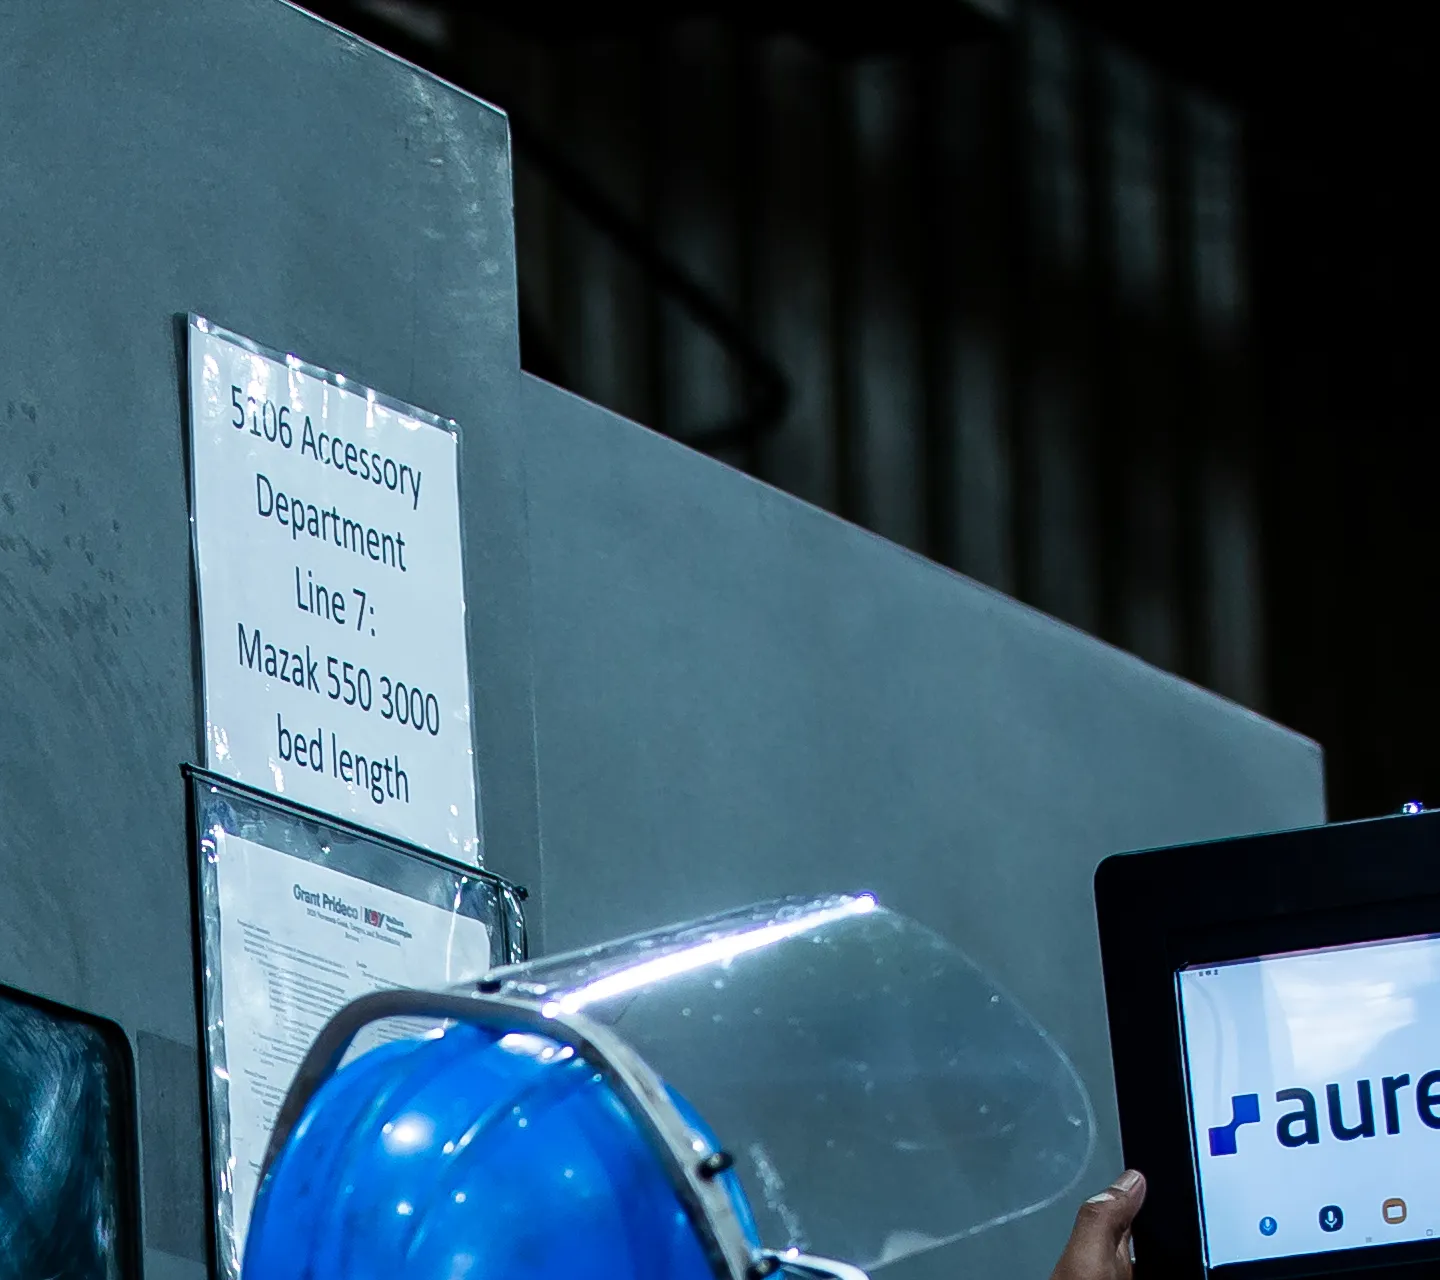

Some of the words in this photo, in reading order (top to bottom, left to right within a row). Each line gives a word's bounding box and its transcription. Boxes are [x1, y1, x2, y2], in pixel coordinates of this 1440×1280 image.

[229, 383, 292, 450] 5106
[298, 412, 423, 513] Accessory
[255, 472, 407, 573] Department
[294, 564, 346, 626] Line
[352, 586, 376, 638] 7:
[236, 618, 320, 695] Mazak
[325, 653, 372, 713] 550
[378, 672, 440, 738] 3000
[276, 710, 323, 774] bed
[330, 730, 410, 807] length
[291, 880, 321, 908] Grant
[322, 891, 358, 921] Prideco
